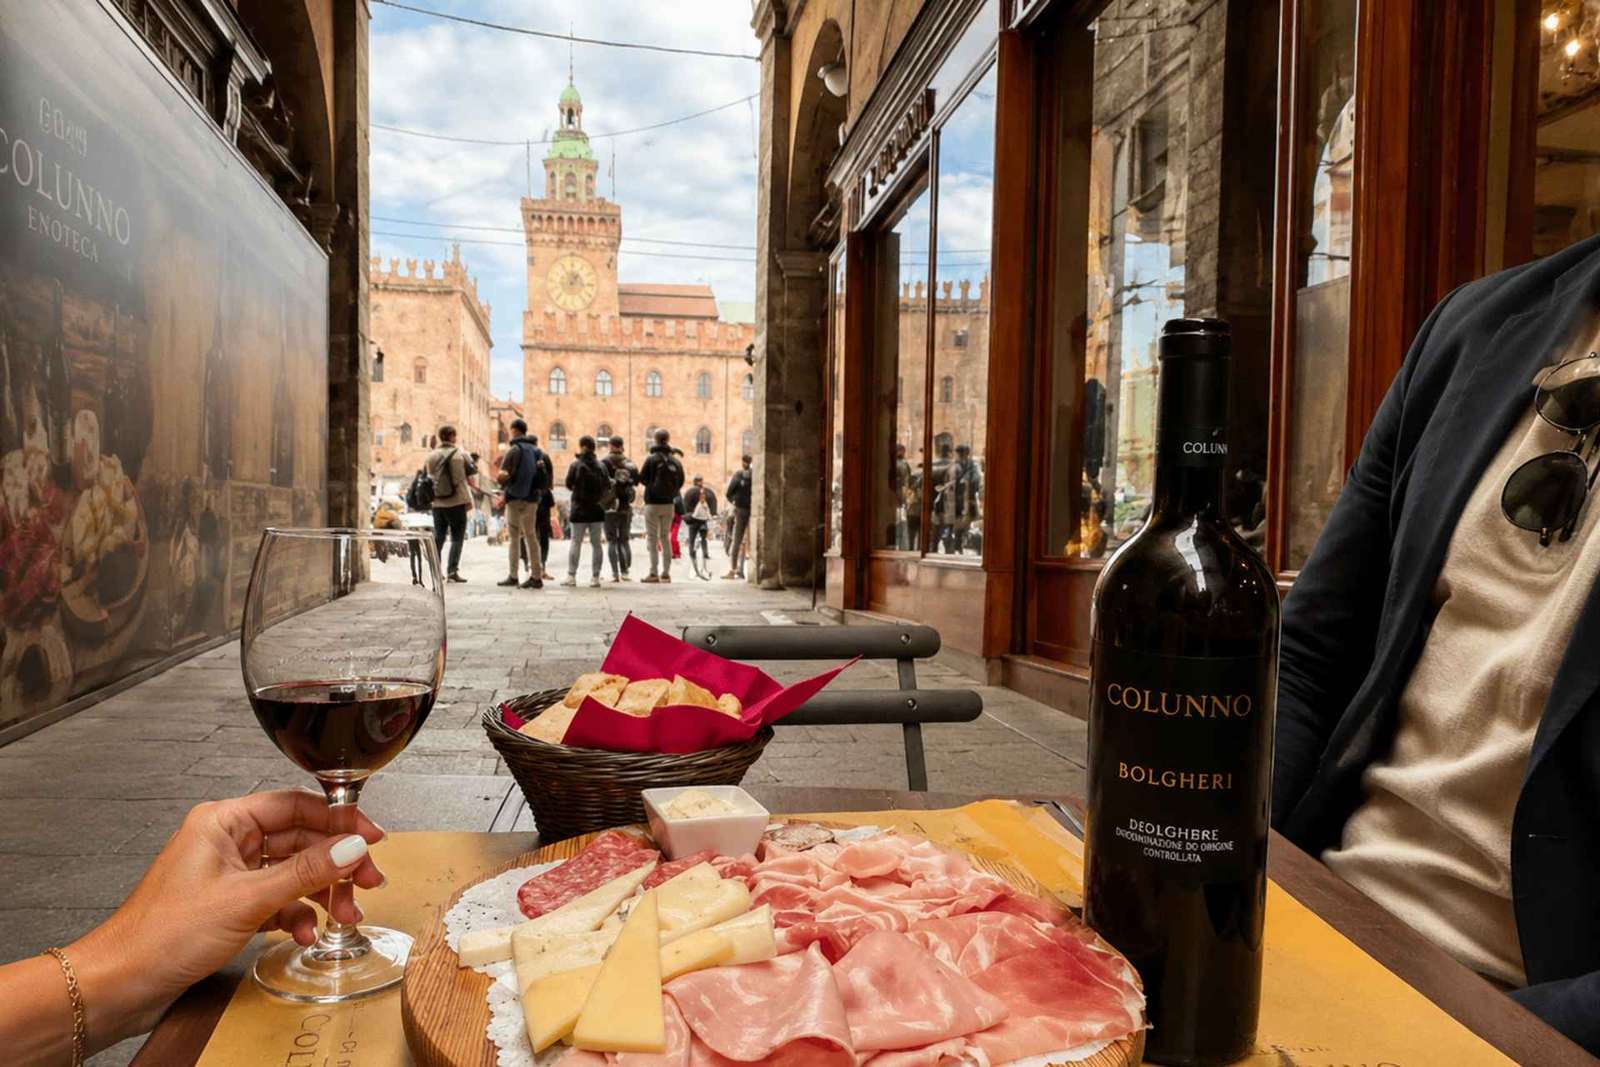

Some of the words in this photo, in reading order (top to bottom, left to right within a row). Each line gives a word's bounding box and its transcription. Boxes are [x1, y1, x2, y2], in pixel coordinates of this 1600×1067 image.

[28, 205, 98, 263] ENOTECA
[1107, 683, 1252, 718] COLUNNO
[1119, 761, 1233, 790] BOLGHERI
[285, 1013, 333, 1067] COL
